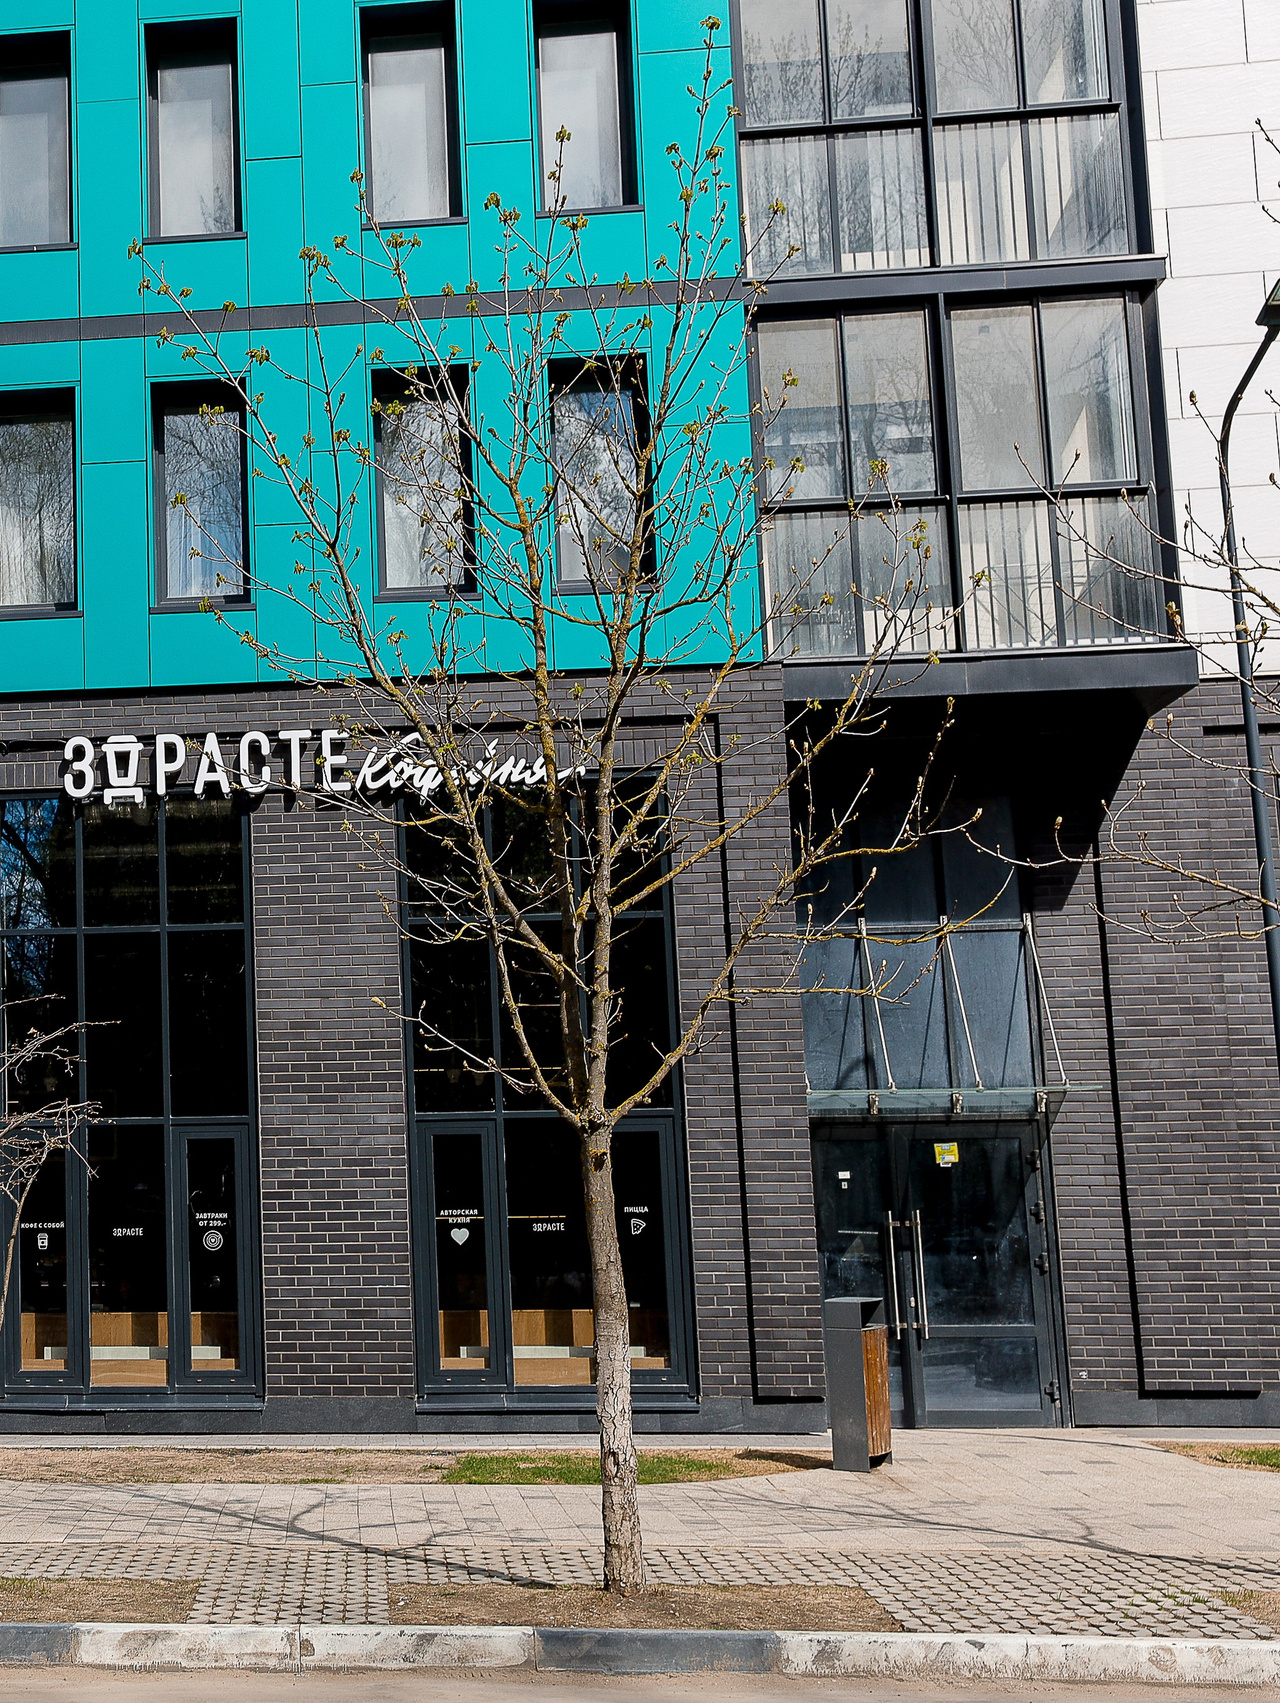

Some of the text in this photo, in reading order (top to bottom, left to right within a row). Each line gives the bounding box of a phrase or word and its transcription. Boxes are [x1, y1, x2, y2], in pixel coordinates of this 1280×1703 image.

[63, 730, 352, 804] ЗДРАСТЕ
[43, 1220, 65, 1229] СОБОЙ
[532, 1222, 565, 1232] ЗДРАСТЕ
[112, 1227, 144, 1237] ЗДРАСТЕ
